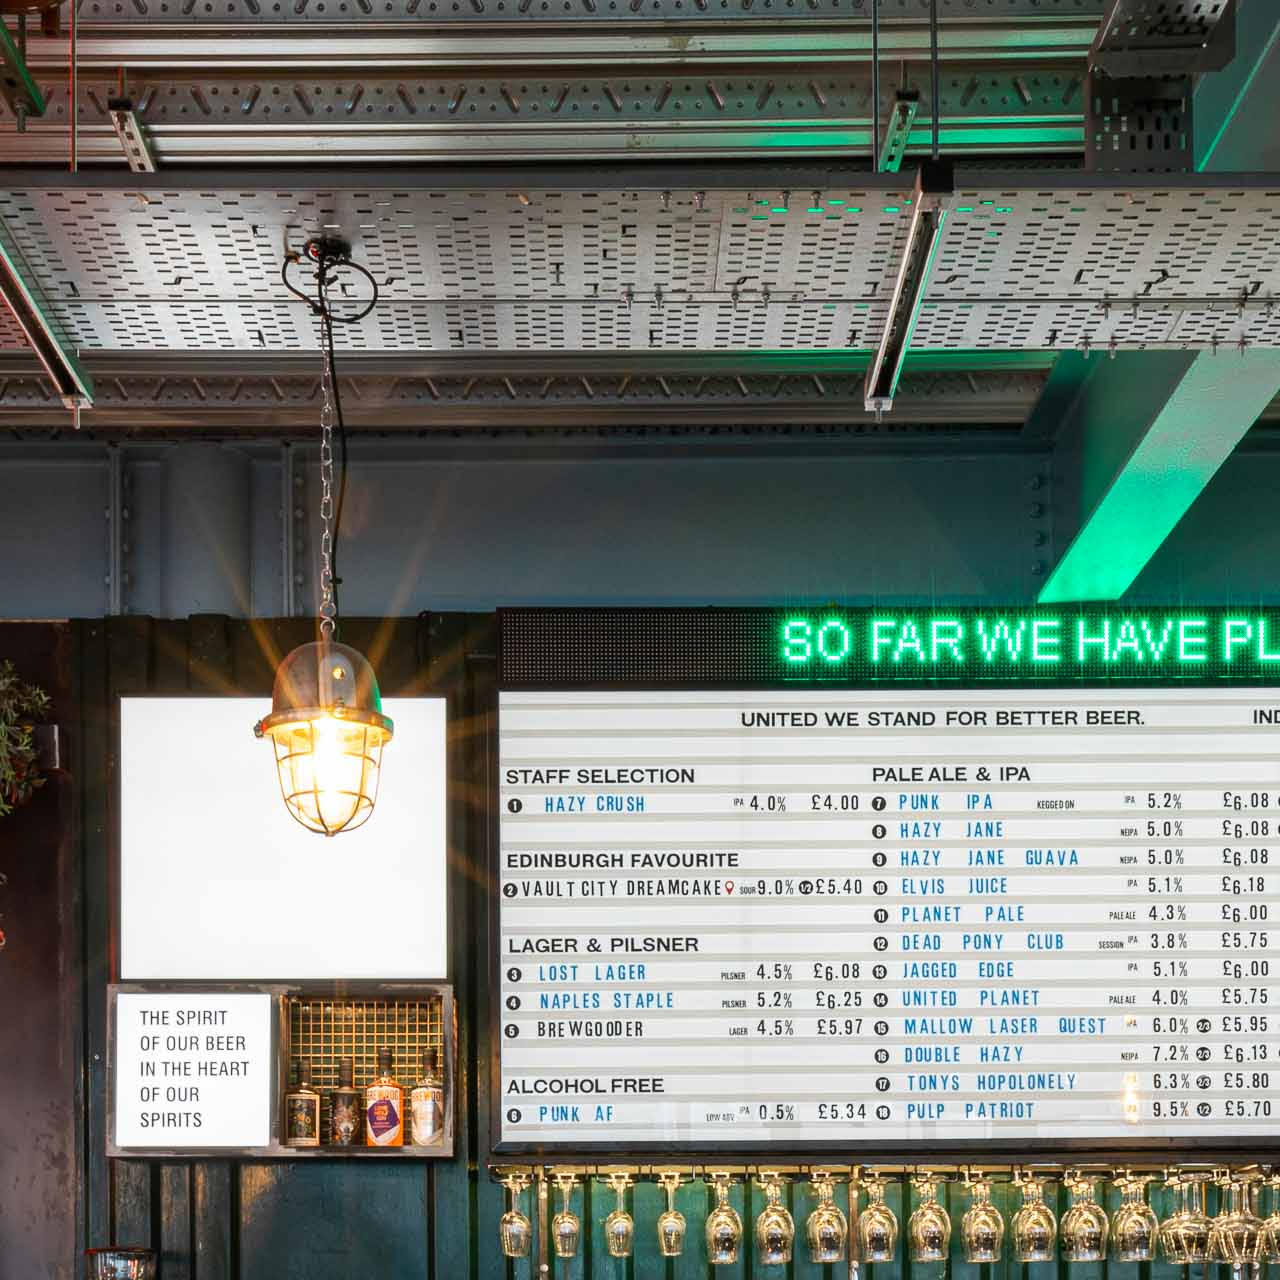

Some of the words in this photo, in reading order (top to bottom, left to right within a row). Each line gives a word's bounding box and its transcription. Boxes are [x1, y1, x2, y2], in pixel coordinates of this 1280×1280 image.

[783, 619, 850, 663] SO
[872, 619, 963, 662] FAR
[976, 619, 1061, 662] WE
[1078, 618, 1207, 662] HAVE
[742, 712, 817, 727] UNITED
[825, 712, 859, 726] WE
[868, 712, 935, 726] STAND
[946, 711, 987, 725] FOR
[996, 711, 1077, 725] BETTER
[1087, 711, 1144, 725] BEER.
[507, 770, 570, 784] STAFF
[577, 769, 694, 783] SELECTION
[873, 768, 923, 782] PALE
[928, 767, 967, 781] ALE
[976, 767, 991, 781] &
[1000, 767, 1030, 781] IPA
[546, 796, 585, 812] HAZY
[597, 796, 644, 811] CRUSH
[900, 794, 938, 810] PUNK
[968, 794, 992, 809] IPA
[901, 822, 940, 838] HAZY
[968, 822, 1002, 837] JANE
[507, 854, 623, 868] EDINBURGH
[632, 853, 738, 867] FAVOURITE
[522, 881, 574, 896] VAULT
[582, 880, 617, 896] CITY
[627, 880, 720, 895] DREAMCAKE
[758, 880, 793, 895] 9.0%
[816, 879, 861, 894] £5.40
[902, 906, 960, 922] PLANET
[986, 906, 1023, 921] PALE
[509, 939, 577, 953] LAGER
[587, 938, 601, 952] &
[611, 938, 698, 952] PILSNER
[903, 934, 940, 950] DEAD
[963, 934, 1002, 949] PONY
[1028, 934, 1063, 949] CLUB
[540, 965, 578, 981] LOST
[596, 965, 645, 980] LAGER
[757, 964, 792, 980] 4.5%
[814, 963, 859, 981] £6.08
[141, 1011, 168, 1024] THE
[177, 1011, 226, 1025] SPIRIT
[905, 1019, 972, 1034] MALLOW
[990, 1018, 1037, 1034] LASER
[1059, 1018, 1105, 1033] QUEST
[1153, 1018, 1187, 1033] 6.0%
[1223, 1016, 1267, 1032] £5.95
[141, 1036, 159, 1050] OF
[167, 1036, 198, 1050] OUR
[207, 1036, 245, 1050] BEER
[141, 1062, 154, 1075] IN
[163, 1062, 190, 1076] THE
[199, 1062, 248, 1075] HEART
[141, 1087, 159, 1101] OF
[167, 1087, 198, 1101] OUR
[507, 1079, 606, 1094] ALCOHOL
[612, 1079, 664, 1093] FREE
[141, 1113, 201, 1127] SPIRITS
[540, 1106, 579, 1121] PUNK
[596, 1106, 612, 1120] AF
